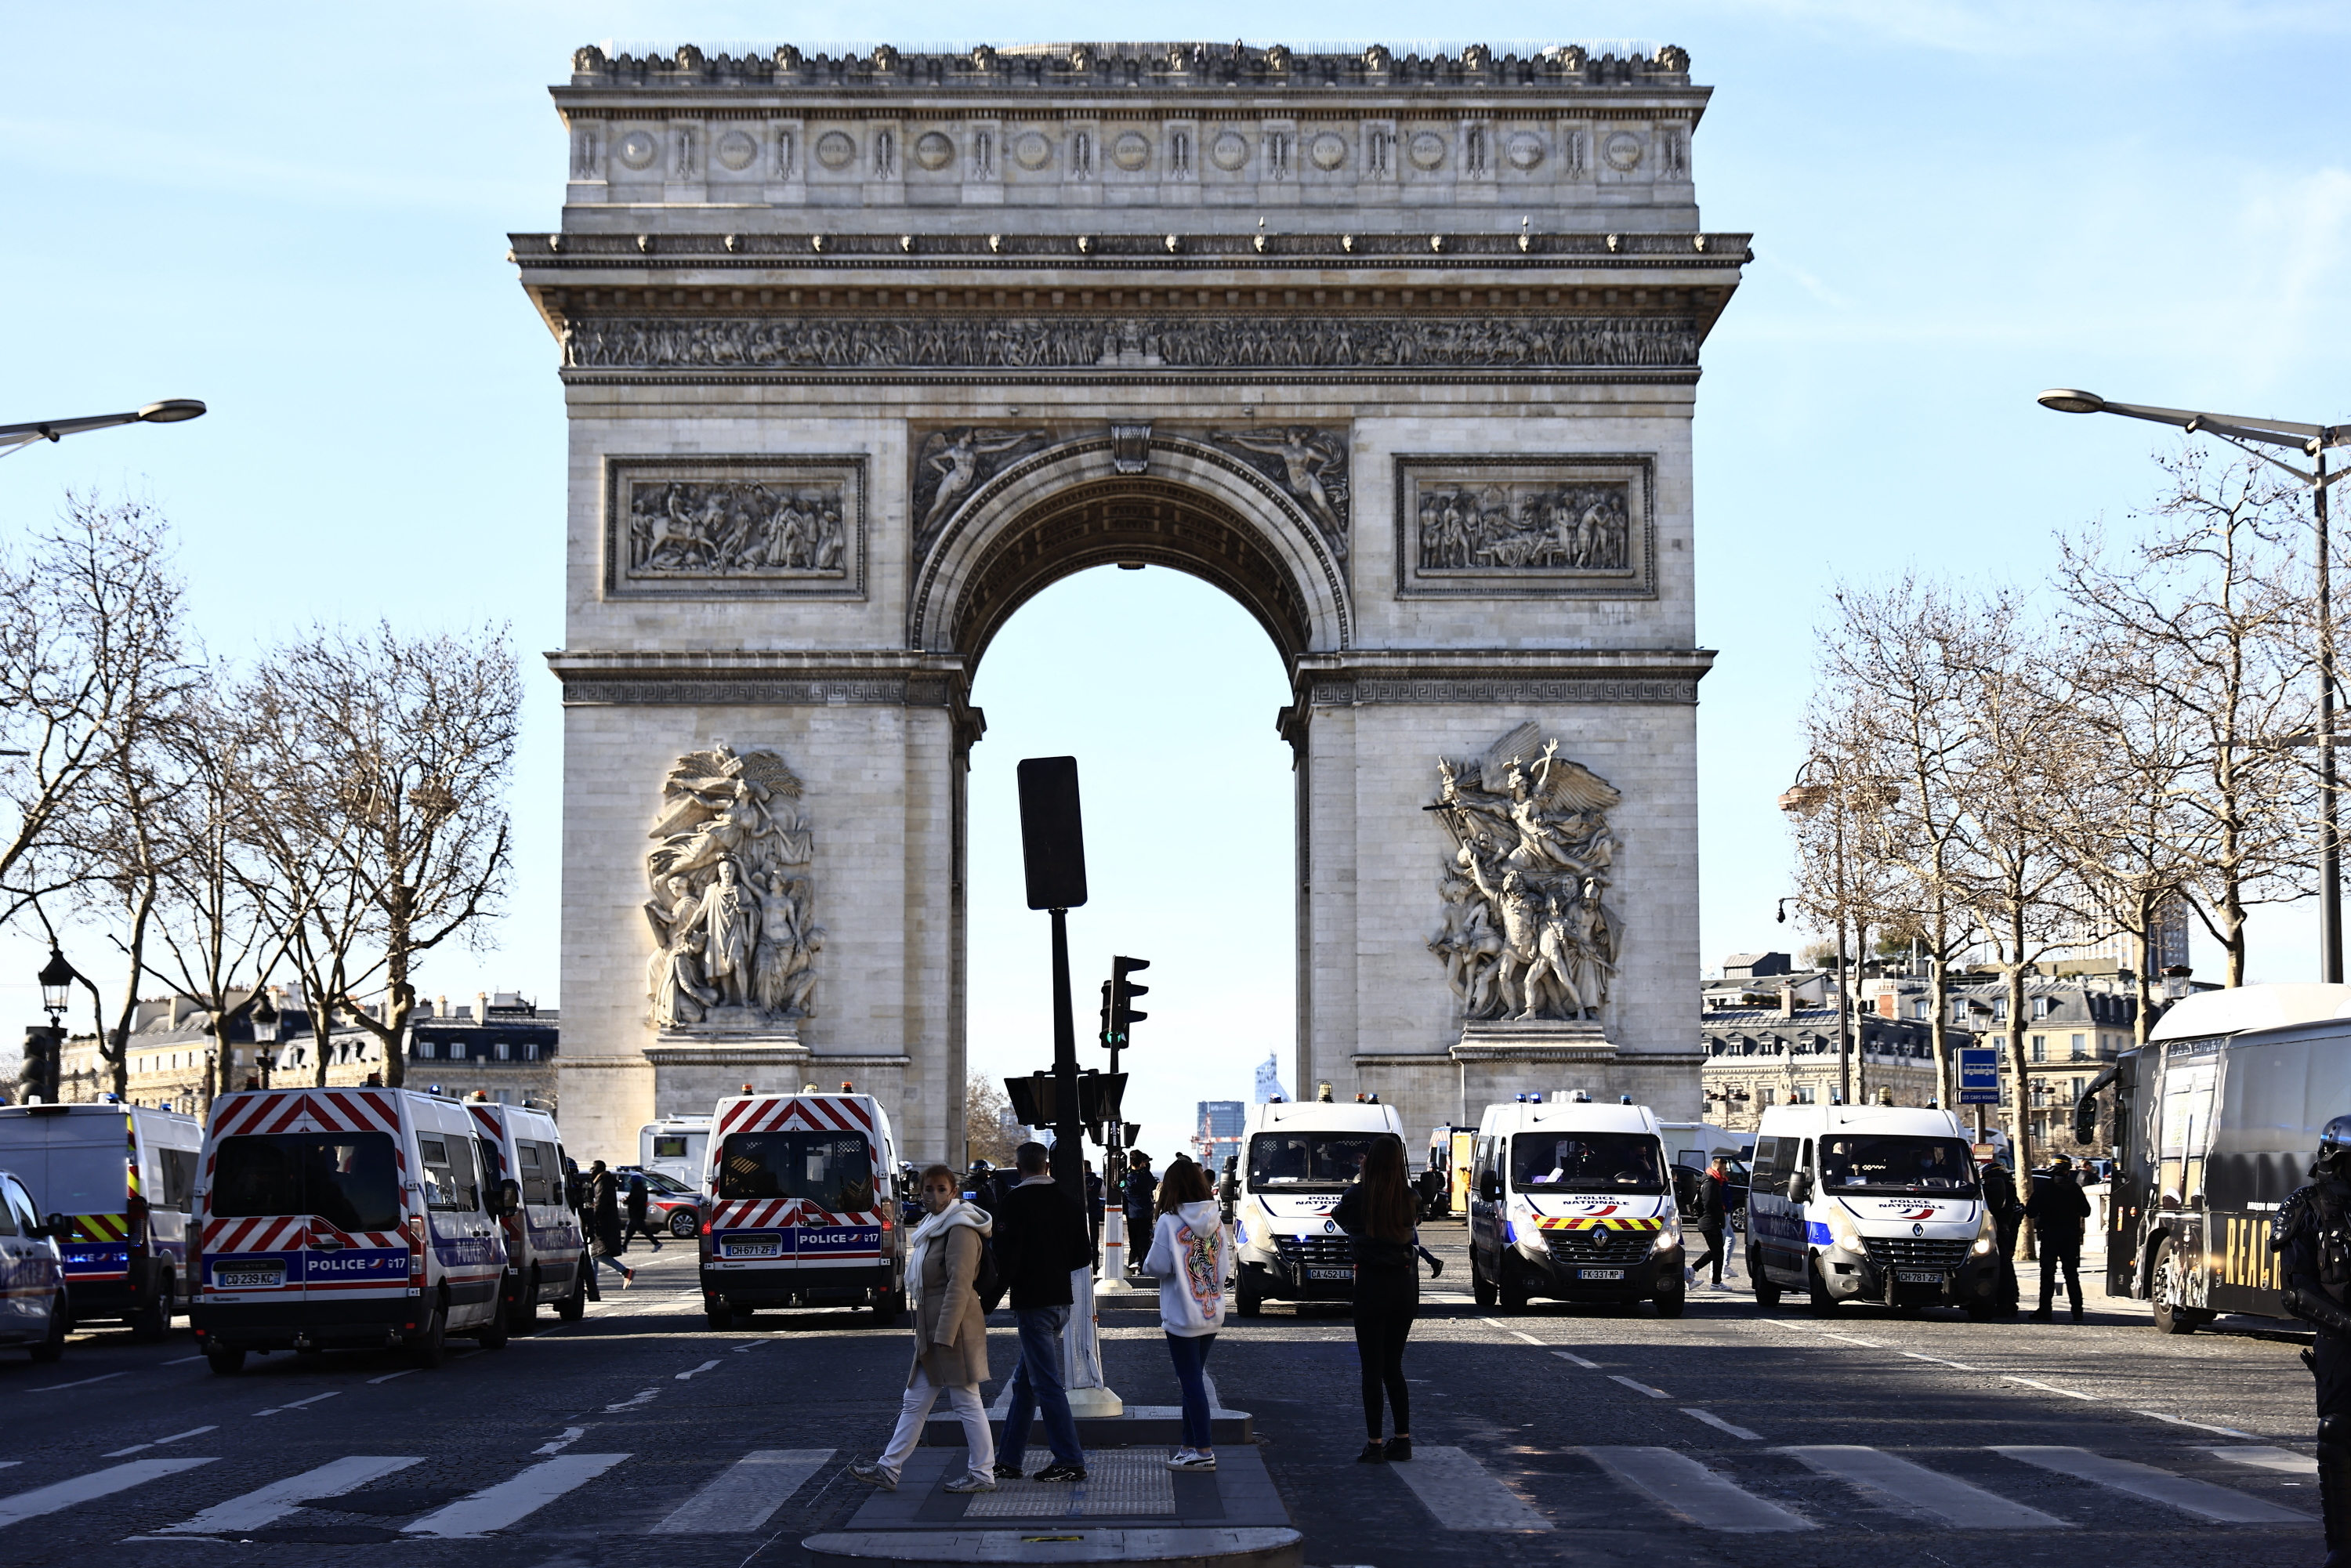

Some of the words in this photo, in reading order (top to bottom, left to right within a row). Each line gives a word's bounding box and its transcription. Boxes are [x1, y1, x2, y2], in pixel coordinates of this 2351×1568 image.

[1023, 145, 1042, 154] LODI
[1316, 145, 1341, 154] RIVOLI
[2246, 1201, 2266, 1211] AMAZON
[1770, 1217, 1790, 1237] POLICE
[799, 1233, 846, 1244] POLICE
[868, 1233, 878, 1242] 17
[456, 1241, 481, 1263] POLICE
[731, 1246, 771, 1255] CH-671-ZF
[308, 1258, 366, 1271] POLICE
[393, 1258, 405, 1269] 17
[1311, 1270, 1349, 1279] CA-452-LL
[1582, 1270, 1619, 1279] FK-337-MP
[1900, 1273, 1937, 1282] CH-781-ZF
